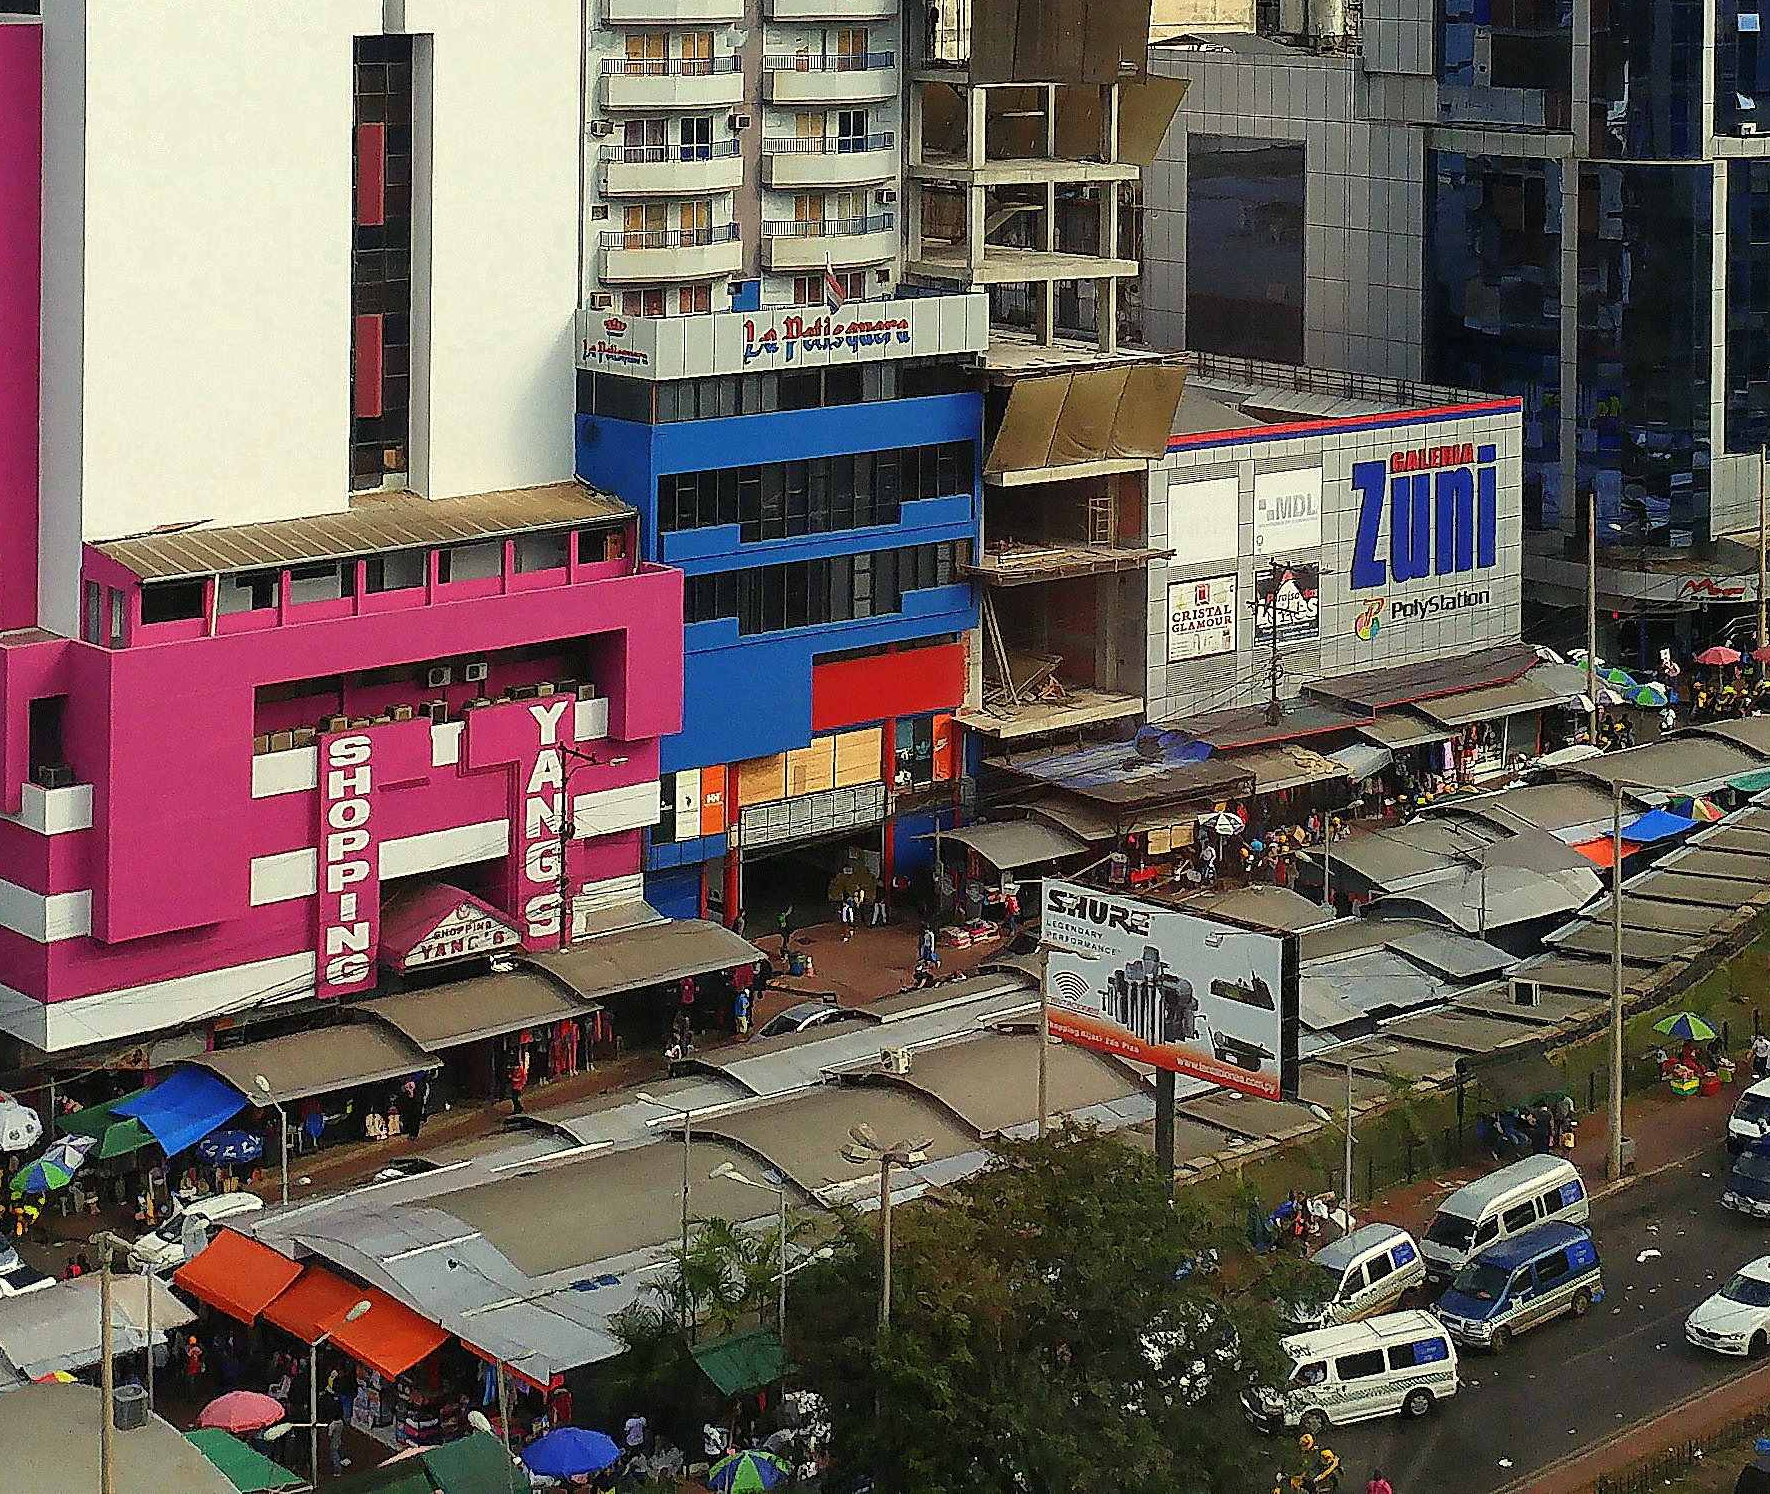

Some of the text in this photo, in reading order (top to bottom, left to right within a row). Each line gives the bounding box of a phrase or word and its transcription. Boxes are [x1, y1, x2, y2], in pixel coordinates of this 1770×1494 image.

[1390, 443, 1475, 473] GALERIA
[1276, 493, 1318, 520] MDL
[1172, 605, 1232, 623] CRISTAL
[1392, 591, 1490, 619] PolyStation
[1172, 616, 1232, 633] GLAMOUR
[326, 735, 371, 986] SHOPPING
[1048, 890, 1150, 936] SHURE
[1046, 920, 1104, 939] LEGENDARY
